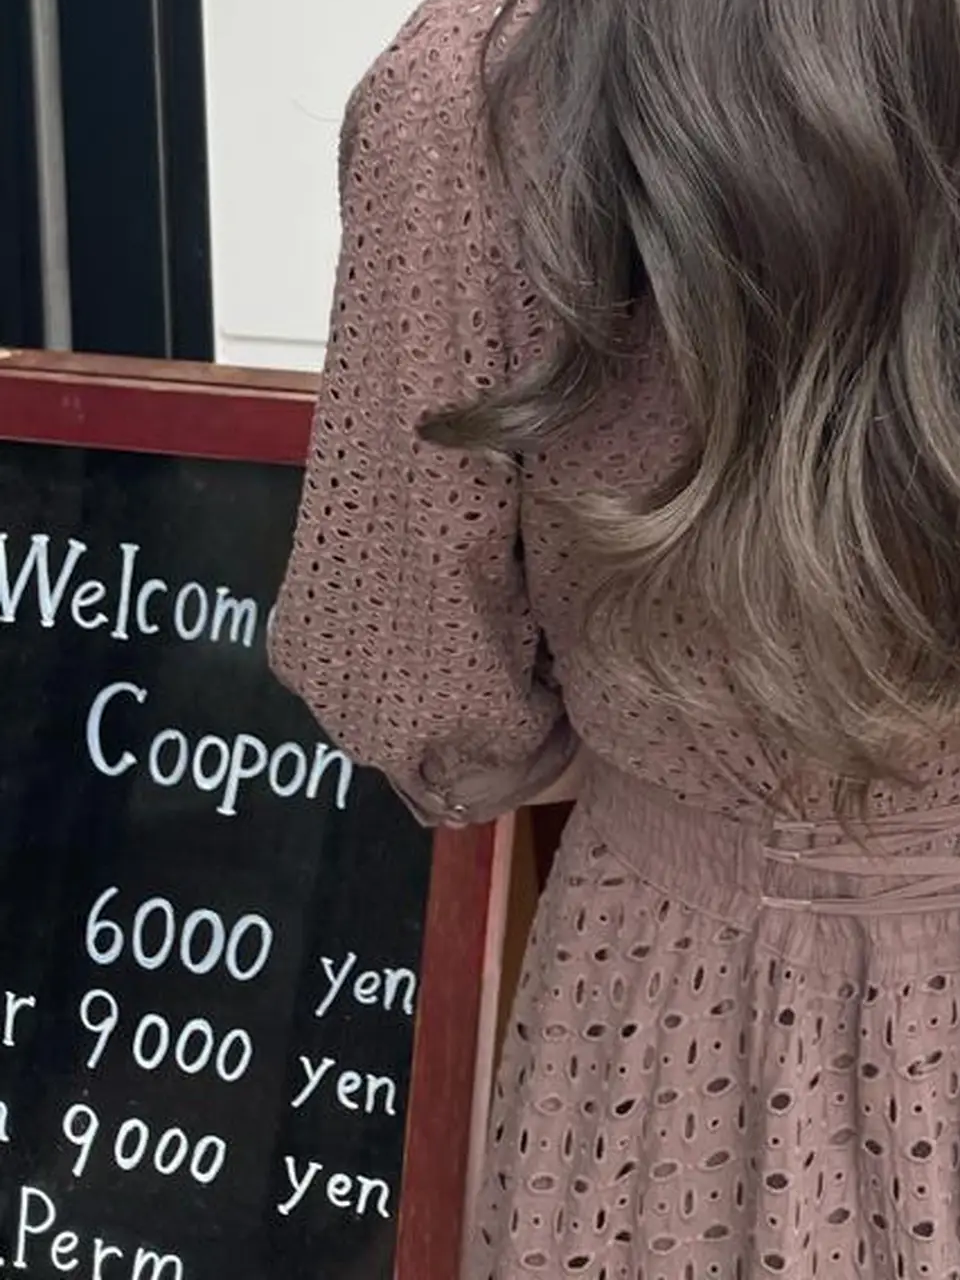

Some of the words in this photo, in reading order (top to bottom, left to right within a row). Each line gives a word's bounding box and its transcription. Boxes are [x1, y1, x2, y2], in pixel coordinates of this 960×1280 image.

[0, 533, 274, 648] Welcom
[86, 681, 354, 816] Coopon
[85, 886, 274, 981] 6000
[315, 951, 418, 1017] yen
[79, 989, 253, 1082] 9000
[291, 1055, 397, 1116] yen
[62, 1103, 227, 1184] 9000
[277, 1155, 391, 1219] yen
